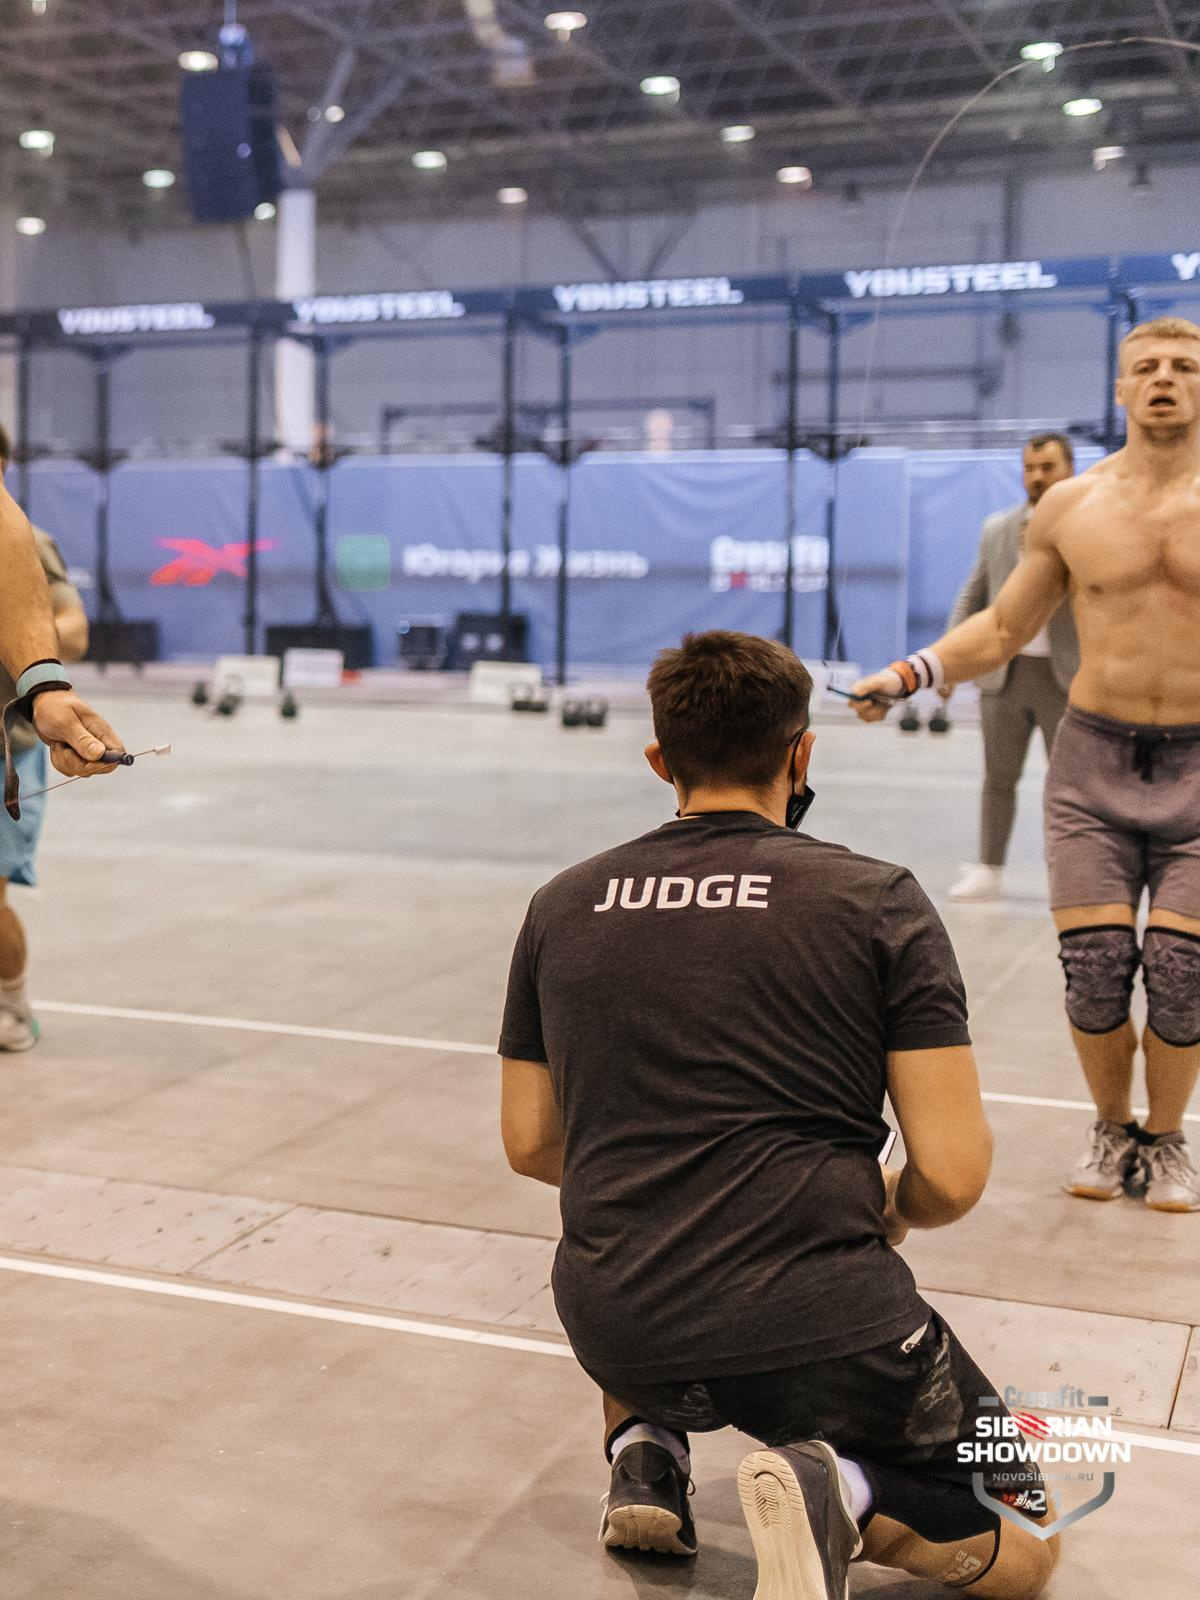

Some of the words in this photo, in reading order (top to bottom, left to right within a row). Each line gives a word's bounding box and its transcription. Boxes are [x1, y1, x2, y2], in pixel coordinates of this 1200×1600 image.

[554, 277, 744, 311] YOUSTEEL
[846, 262, 1057, 297] YOUSTEEL
[58, 303, 214, 334] YOUSTEEL
[294, 291, 465, 322] YOUSTEEL
[594, 874, 772, 912] JUDGE
